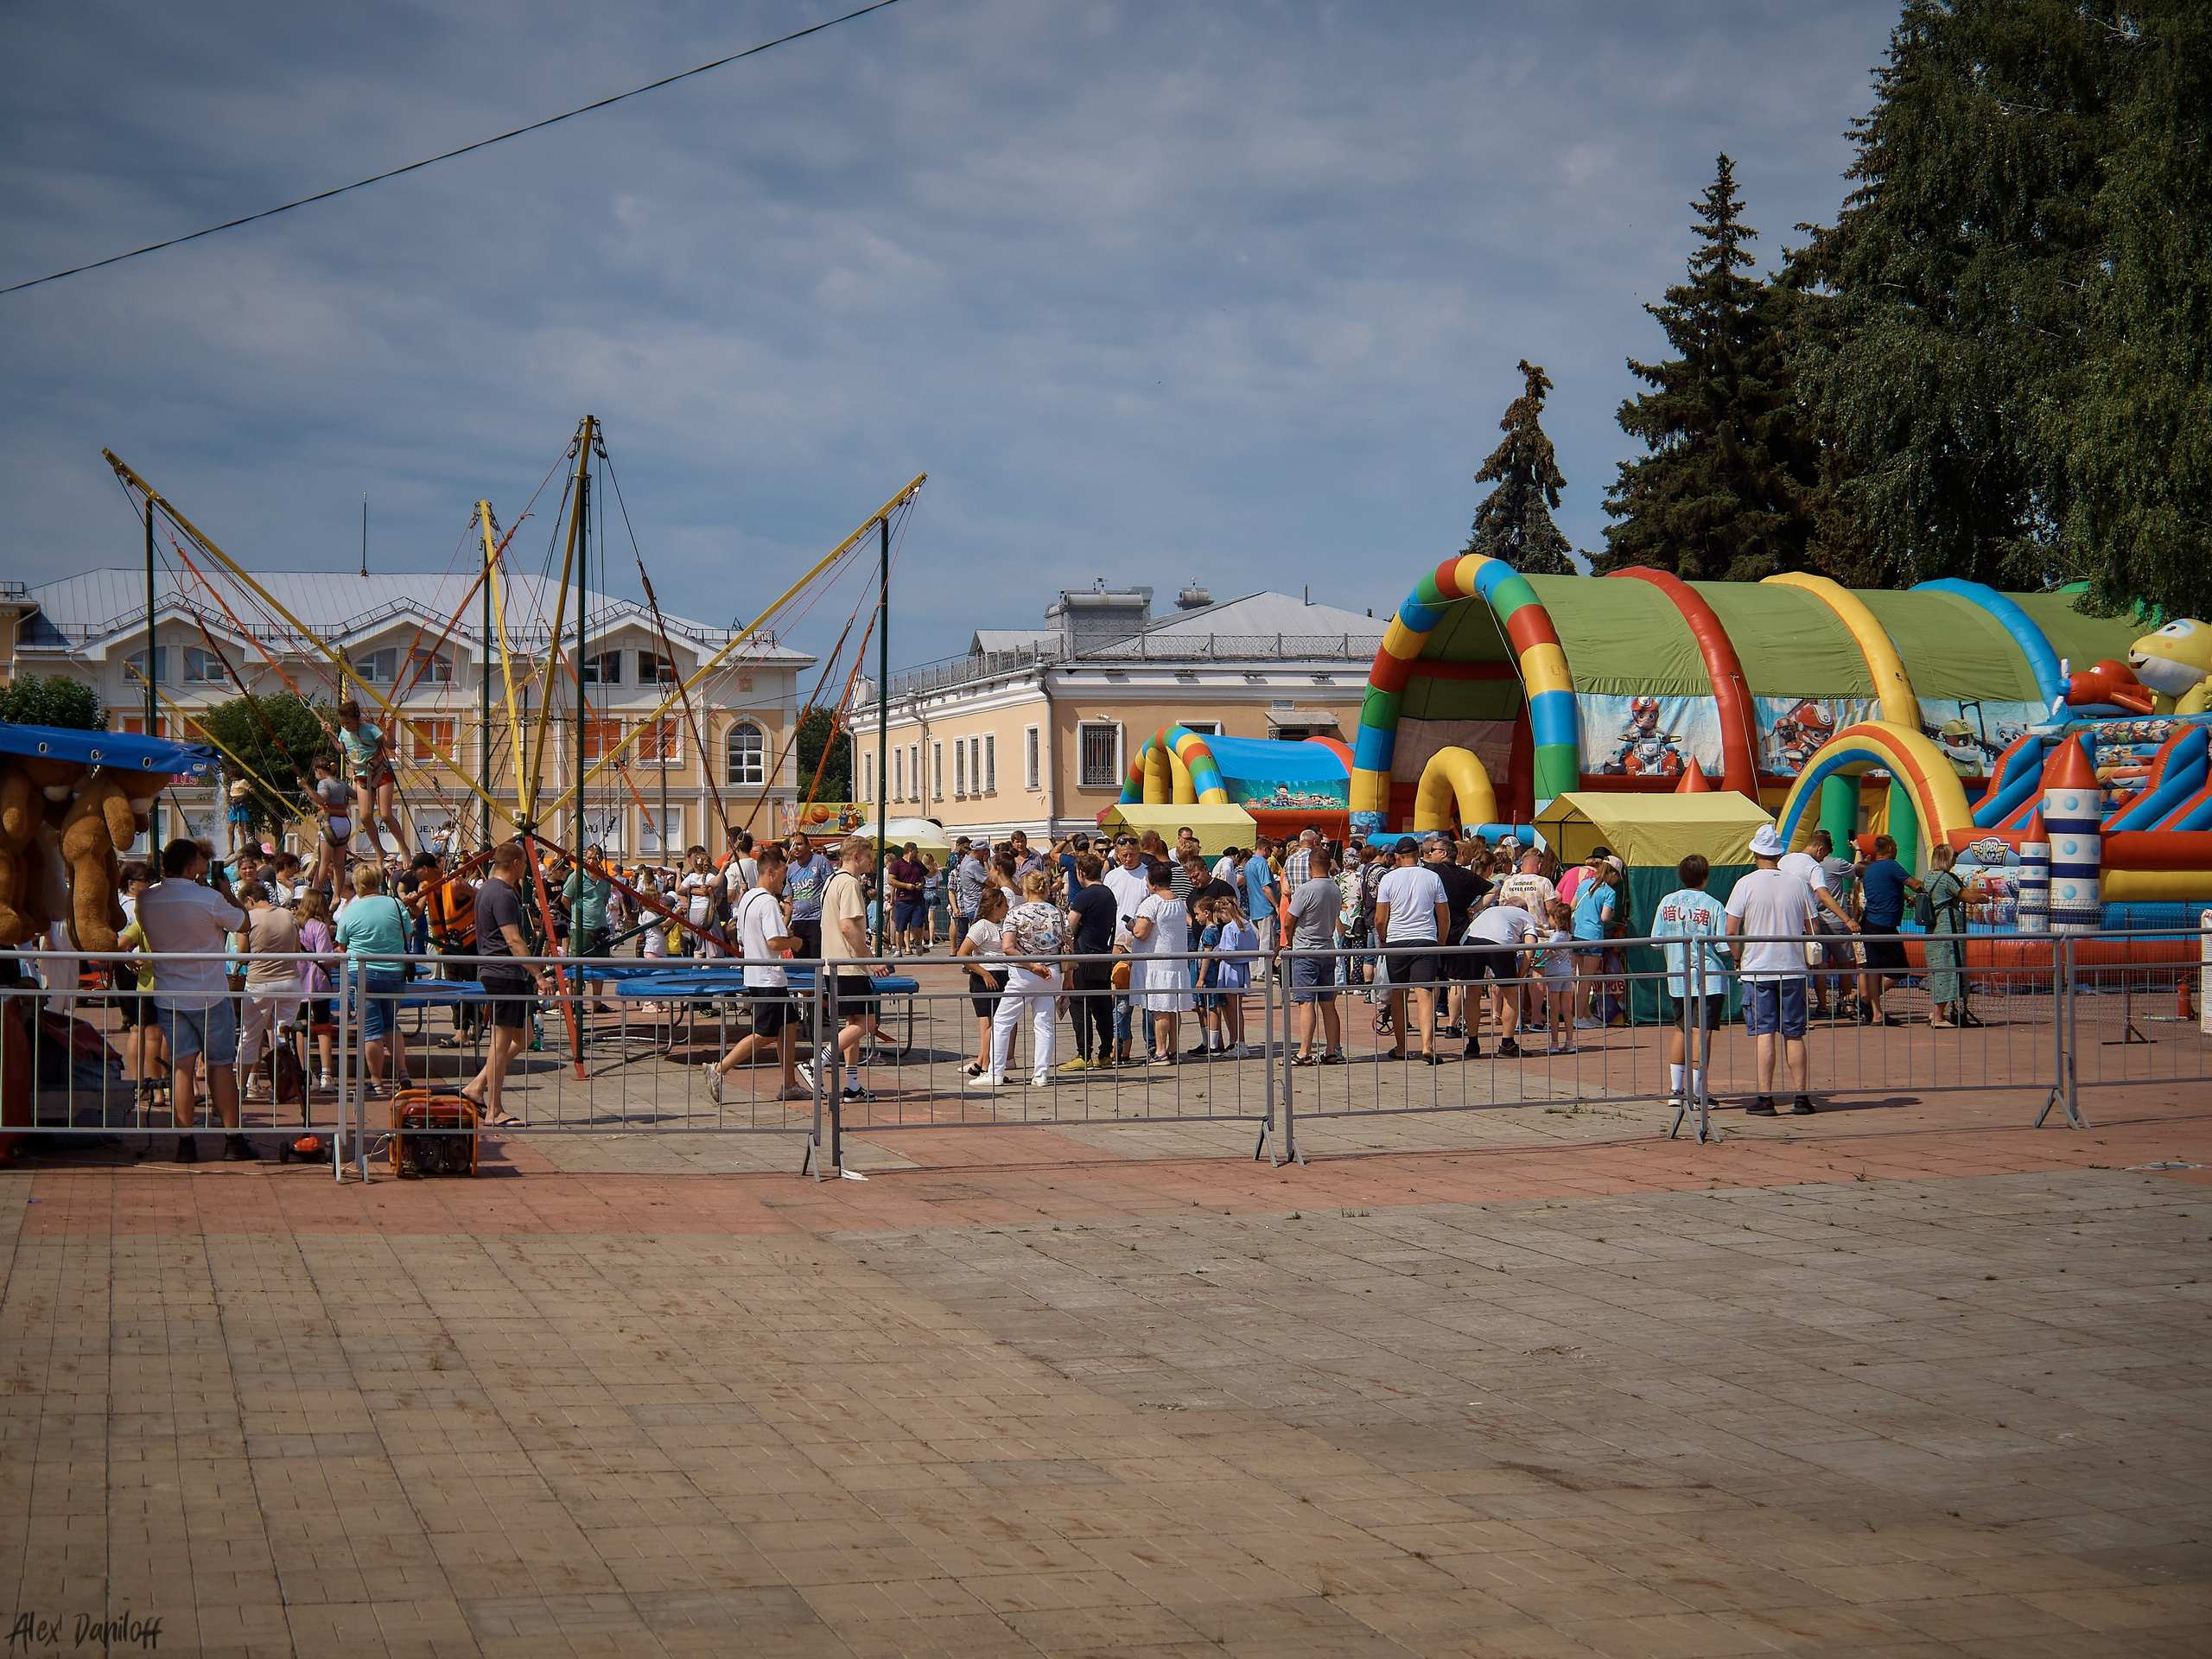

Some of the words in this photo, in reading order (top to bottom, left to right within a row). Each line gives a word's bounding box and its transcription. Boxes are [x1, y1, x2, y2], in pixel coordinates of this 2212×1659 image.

[1980, 841, 1998, 853] SUPER
[1663, 905, 1710, 926] 暗い魂
